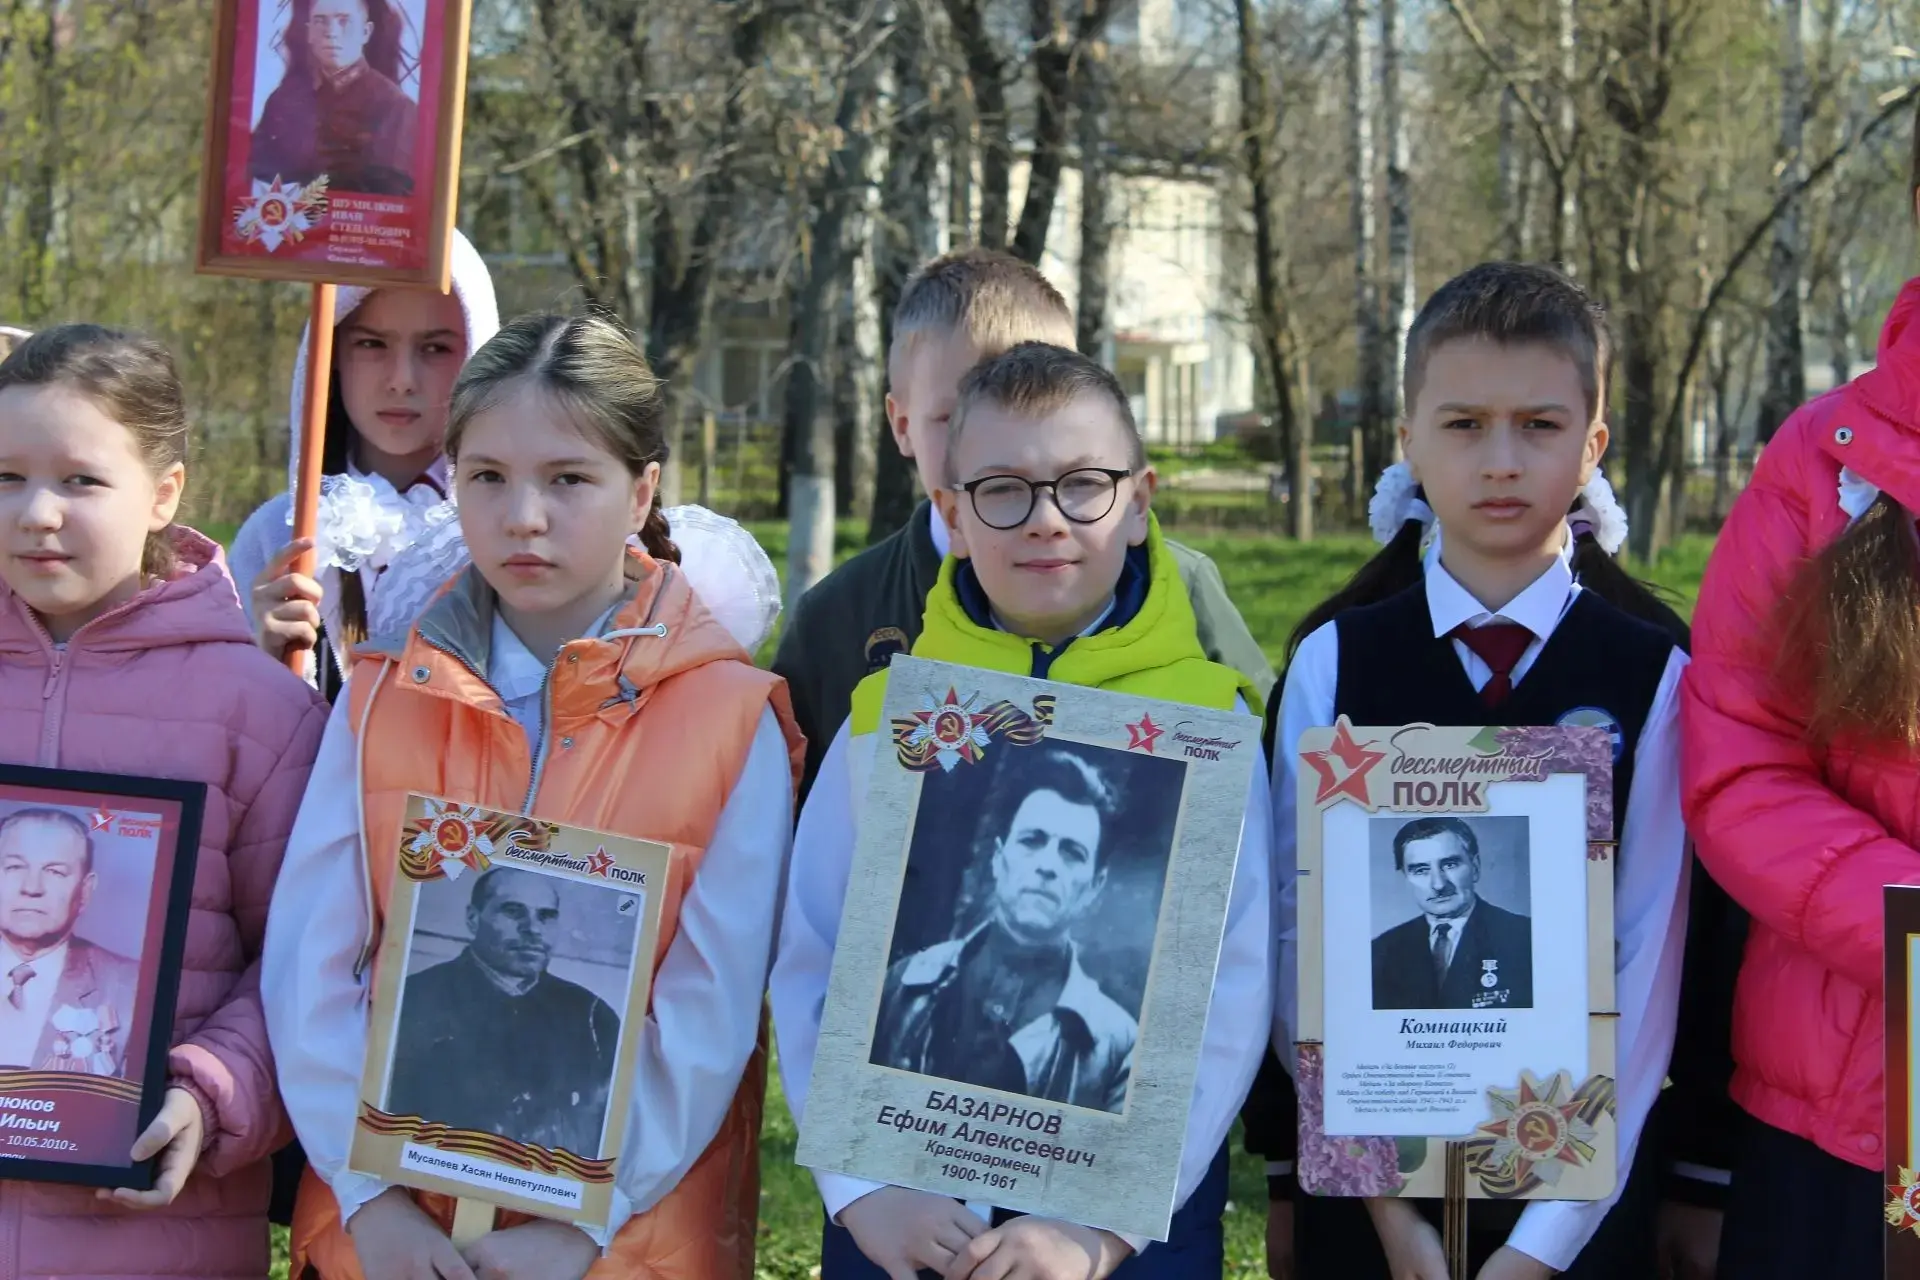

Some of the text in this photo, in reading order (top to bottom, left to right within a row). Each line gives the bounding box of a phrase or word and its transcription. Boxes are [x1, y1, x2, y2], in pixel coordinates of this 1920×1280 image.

[1184, 746, 1220, 761] ПОЛК
[1393, 782, 1482, 806] ПОЛК
[611, 868, 646, 884] ПОЛК
[1399, 1018, 1507, 1036] Комнацкий
[1406, 1040, 1502, 1051] Михаил Федорович
[0, 1113, 60, 1132] Ильич
[926, 1090, 1062, 1135] БАЗАРНОВ
[7, 1135, 69, 1150] 10.05.2010
[877, 1105, 1096, 1168] Ефим Алексеевич
[924, 1139, 1042, 1177] Красноармеец
[408, 1150, 577, 1200] Мусалеев Хасян Невлетуллович
[941, 1164, 1017, 1190] 1900-1961
